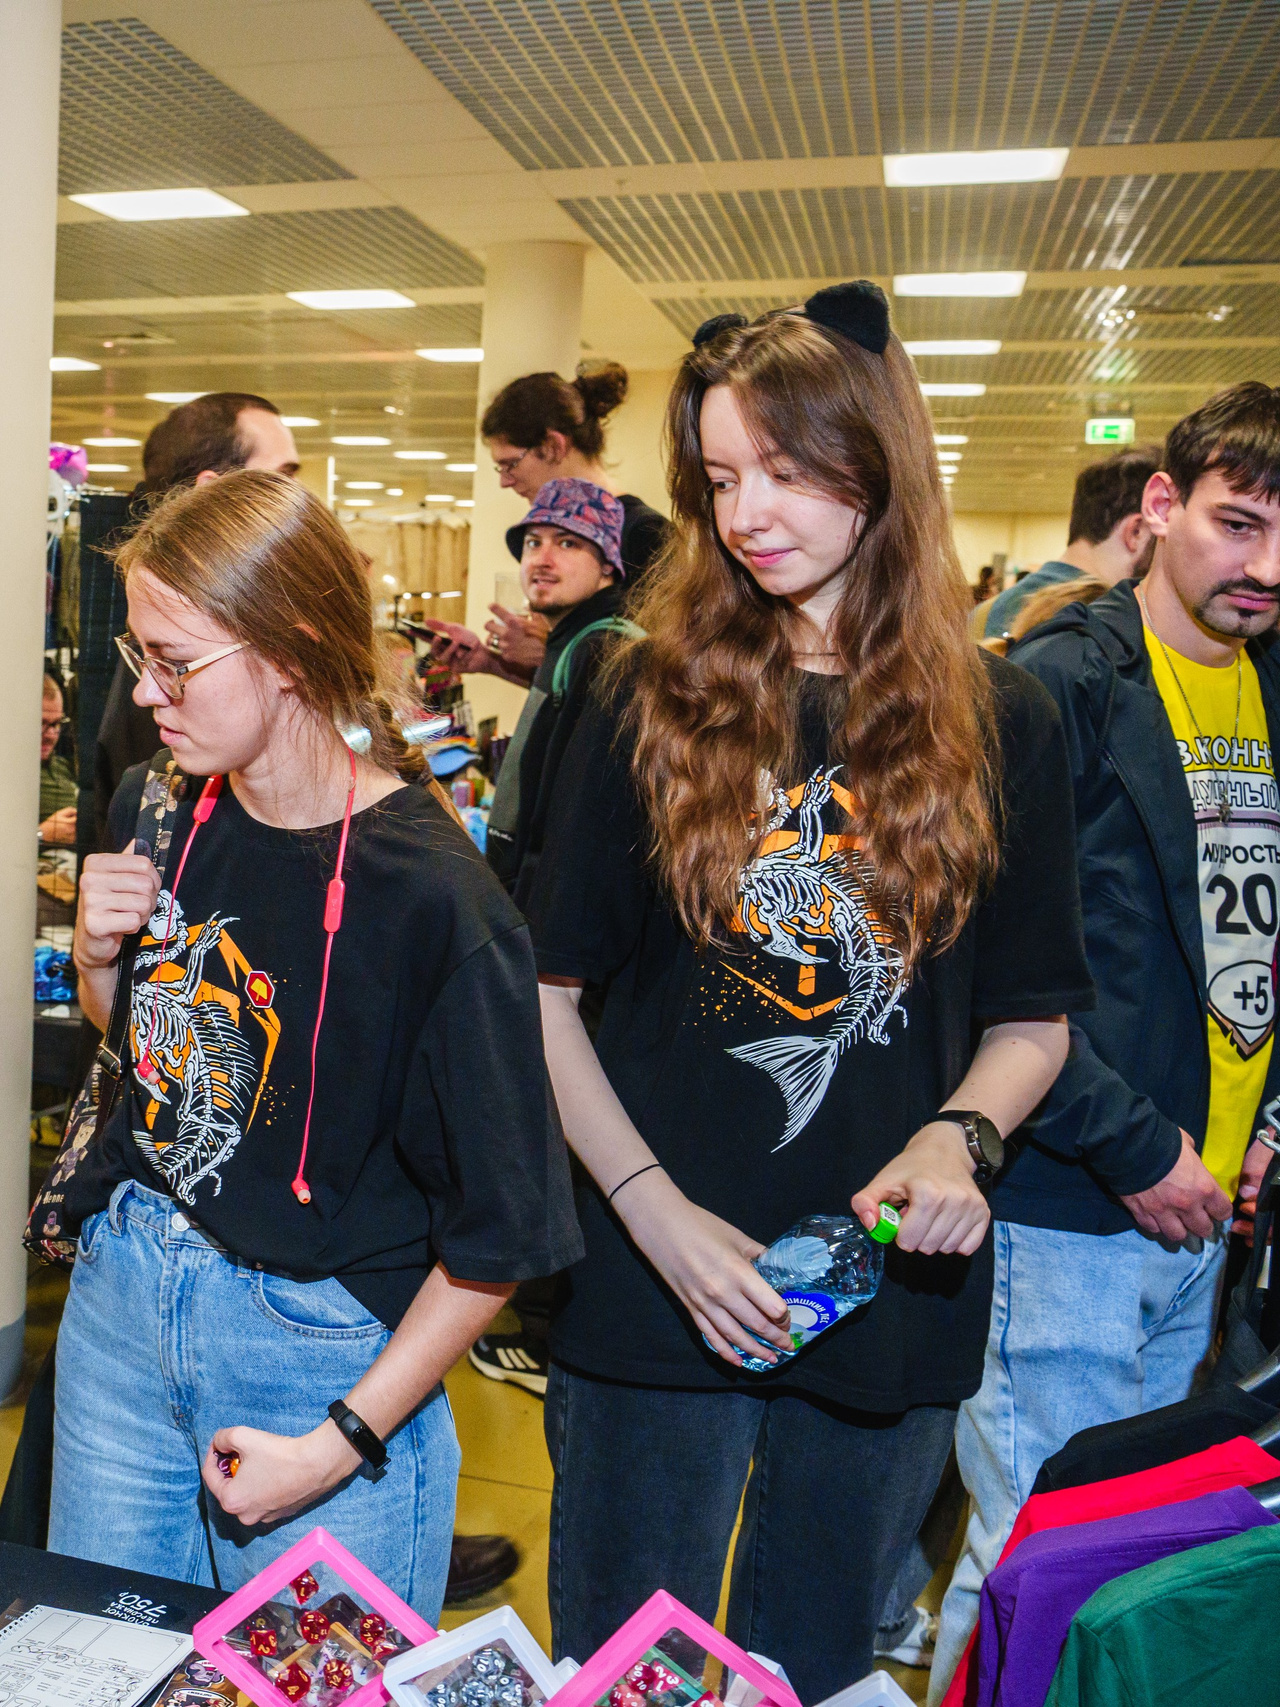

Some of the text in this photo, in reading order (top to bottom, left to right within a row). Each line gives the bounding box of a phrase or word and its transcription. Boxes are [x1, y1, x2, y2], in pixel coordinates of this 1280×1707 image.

[1206, 873, 1278, 936] 20
[1234, 977, 1269, 1015] +5
[784, 1297, 826, 1313] ШИШКИН
[258, 1644, 271, 1654] 2
[654, 1666, 666, 1679] 2
[666, 1675, 680, 1685] 3
